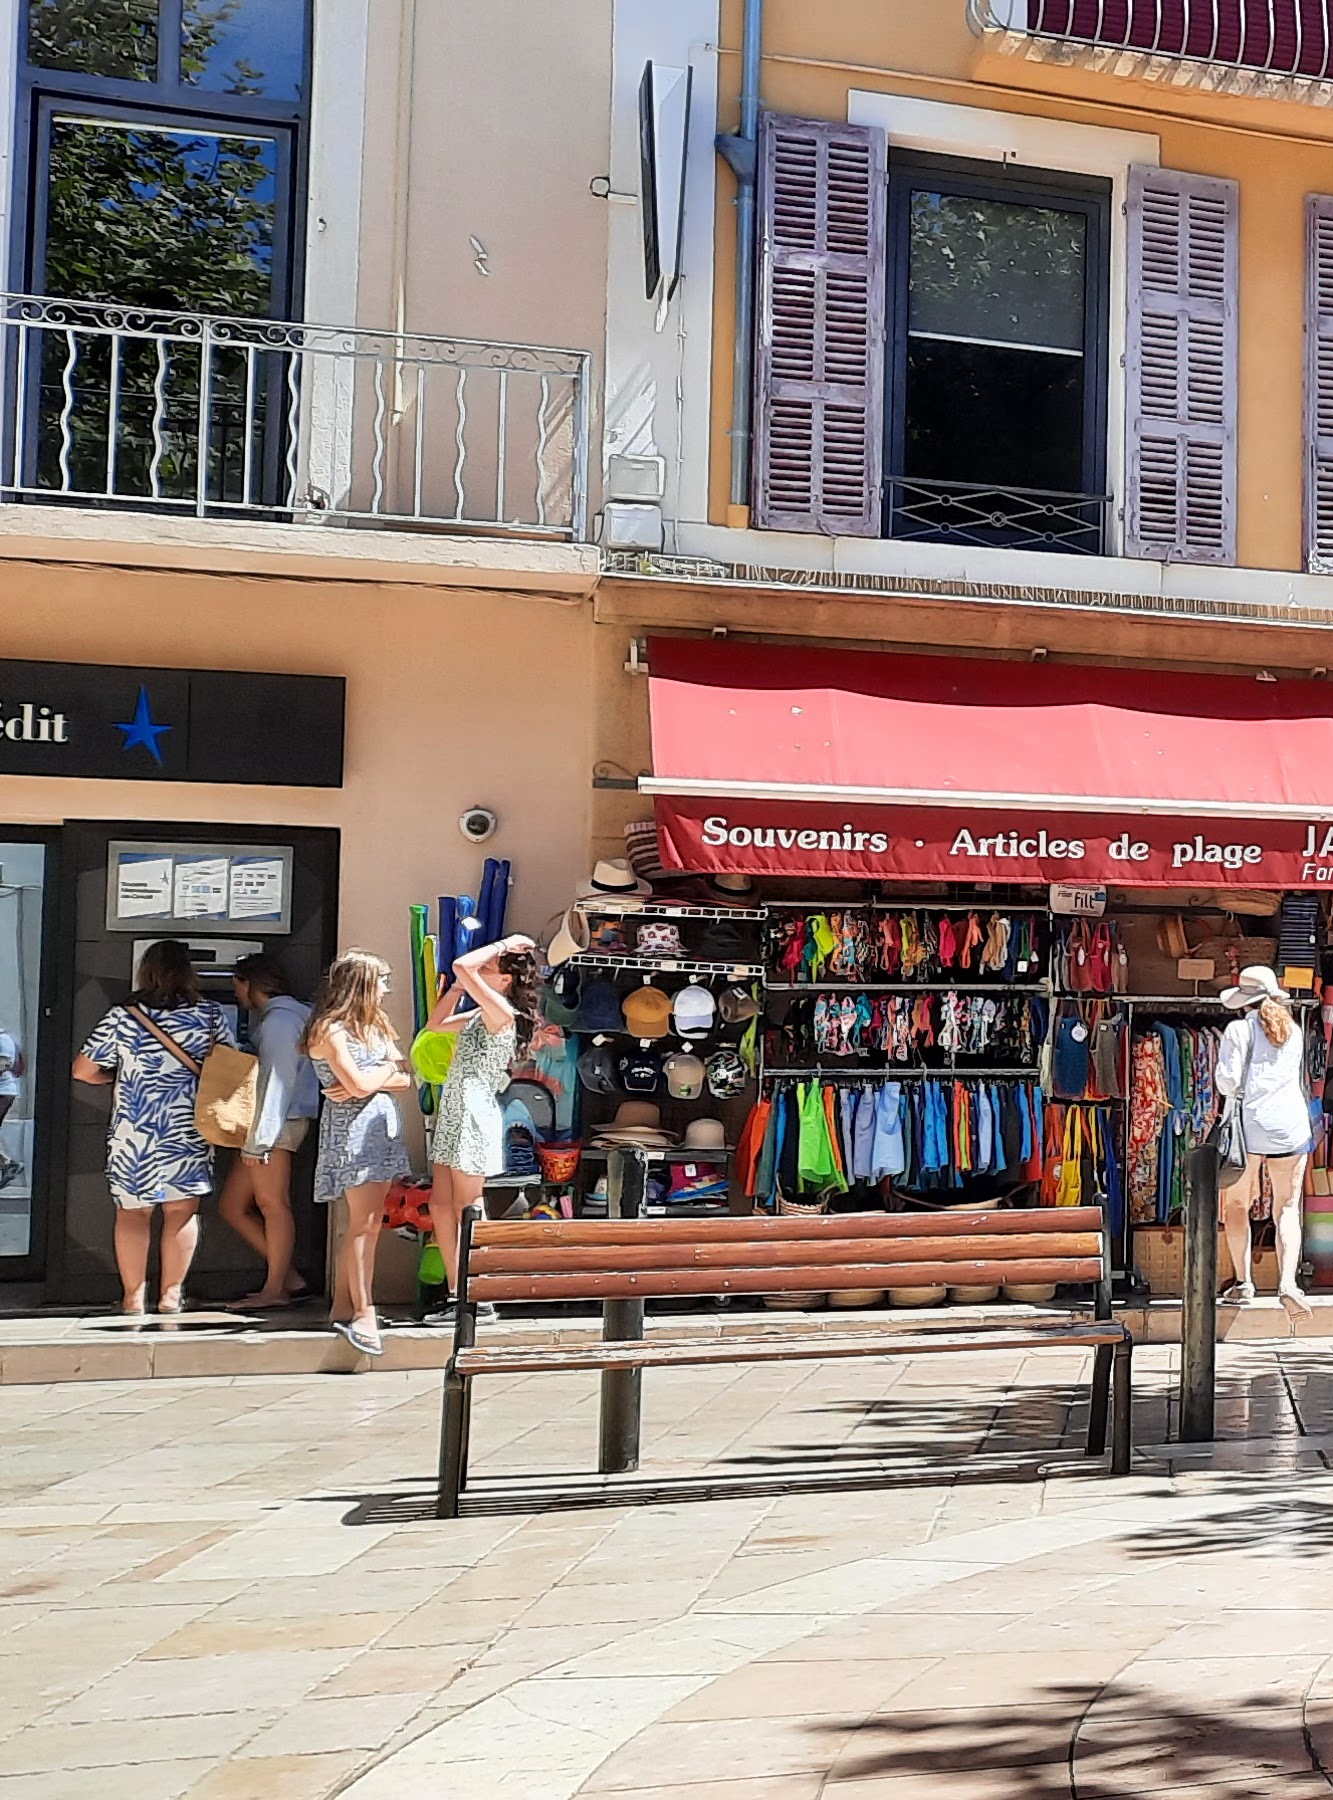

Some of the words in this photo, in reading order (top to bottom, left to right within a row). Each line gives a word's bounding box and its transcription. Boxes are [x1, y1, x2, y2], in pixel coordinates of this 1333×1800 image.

[0, 702, 69, 742] dit
[701, 816, 888, 853] Souvenirs
[949, 828, 1085, 859] Articles
[1109, 833, 1150, 861] de
[1171, 835, 1263, 869] plage
